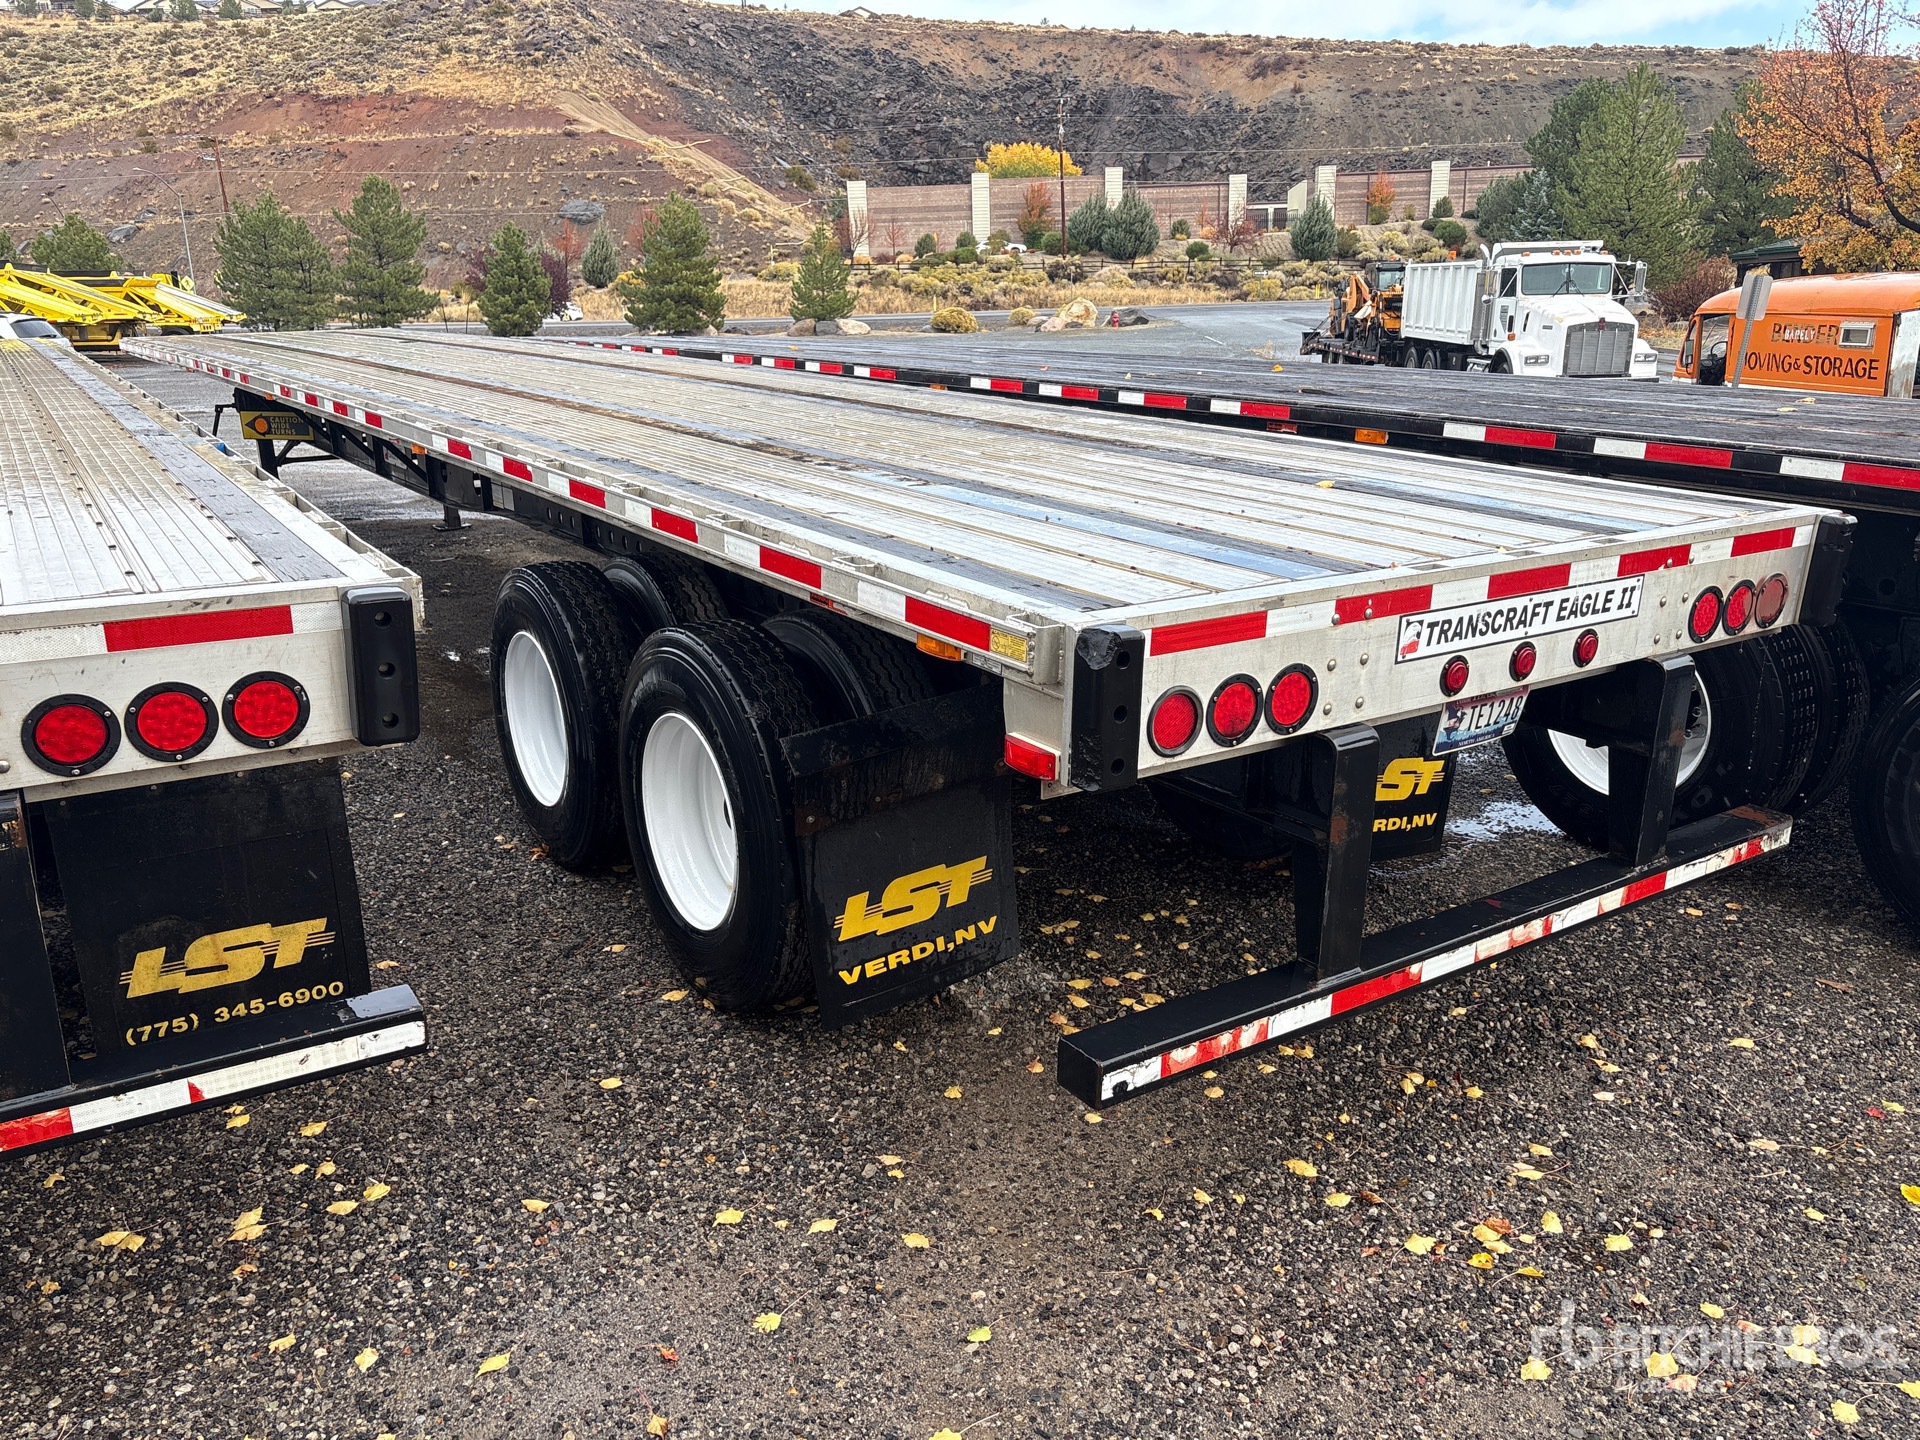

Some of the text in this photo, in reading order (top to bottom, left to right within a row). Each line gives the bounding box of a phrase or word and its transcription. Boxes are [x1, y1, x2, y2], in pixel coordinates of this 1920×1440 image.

[1802, 354, 1880, 381] STORAGE
[1426, 584, 1637, 647] TRANSCRAFT EAGLE II
[1467, 695, 1525, 731] TE1248
[1375, 757, 1445, 801] ST
[1372, 812, 1438, 832] RDI,NV
[836, 855, 991, 942] LST
[122, 917, 333, 999] LST
[838, 915, 998, 985] VERDI,NV
[125, 981, 345, 1046] (775) 345-6900
